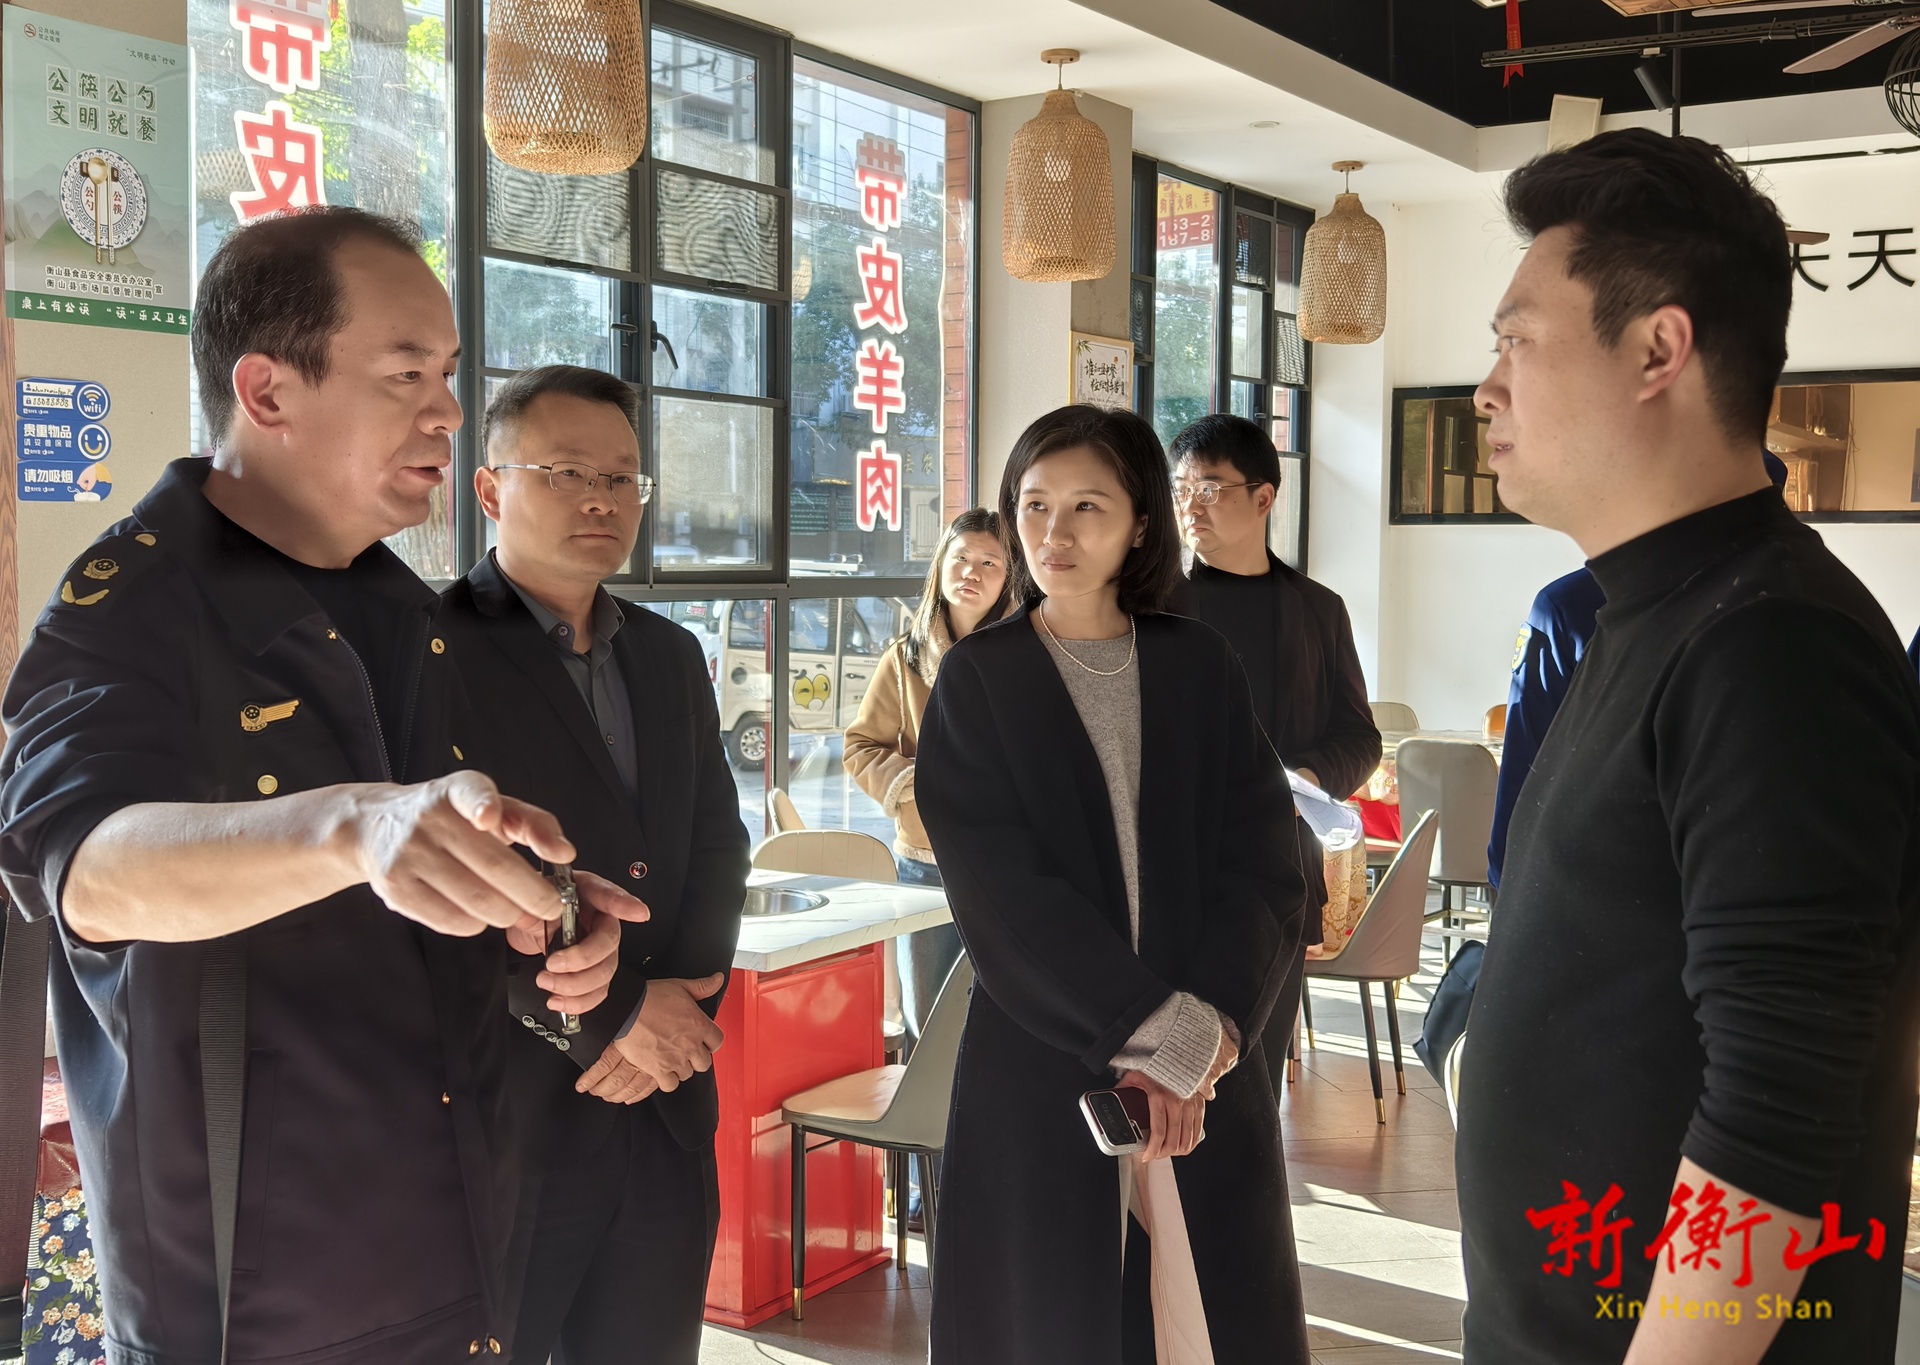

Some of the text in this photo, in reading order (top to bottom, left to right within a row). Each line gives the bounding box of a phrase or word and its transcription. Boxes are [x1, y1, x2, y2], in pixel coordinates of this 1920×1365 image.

[48, 67, 155, 110] 公筷公勺
[50, 100, 156, 141] 文明就餐
[85, 186, 94, 211] 公勺
[112, 191, 123, 215] 公筷
[1159, 228, 1214, 248] 187-8
[45, 265, 153, 287] 衡山县食品安全委员会办公室
[46, 279, 153, 299] 衡山县市场监督管理局
[21, 296, 90, 316] 桌上有公筷
[83, 401, 102, 413] wifi
[23, 423, 72, 439] 贵重物品
[24, 468, 73, 484] 请勿吸烟
